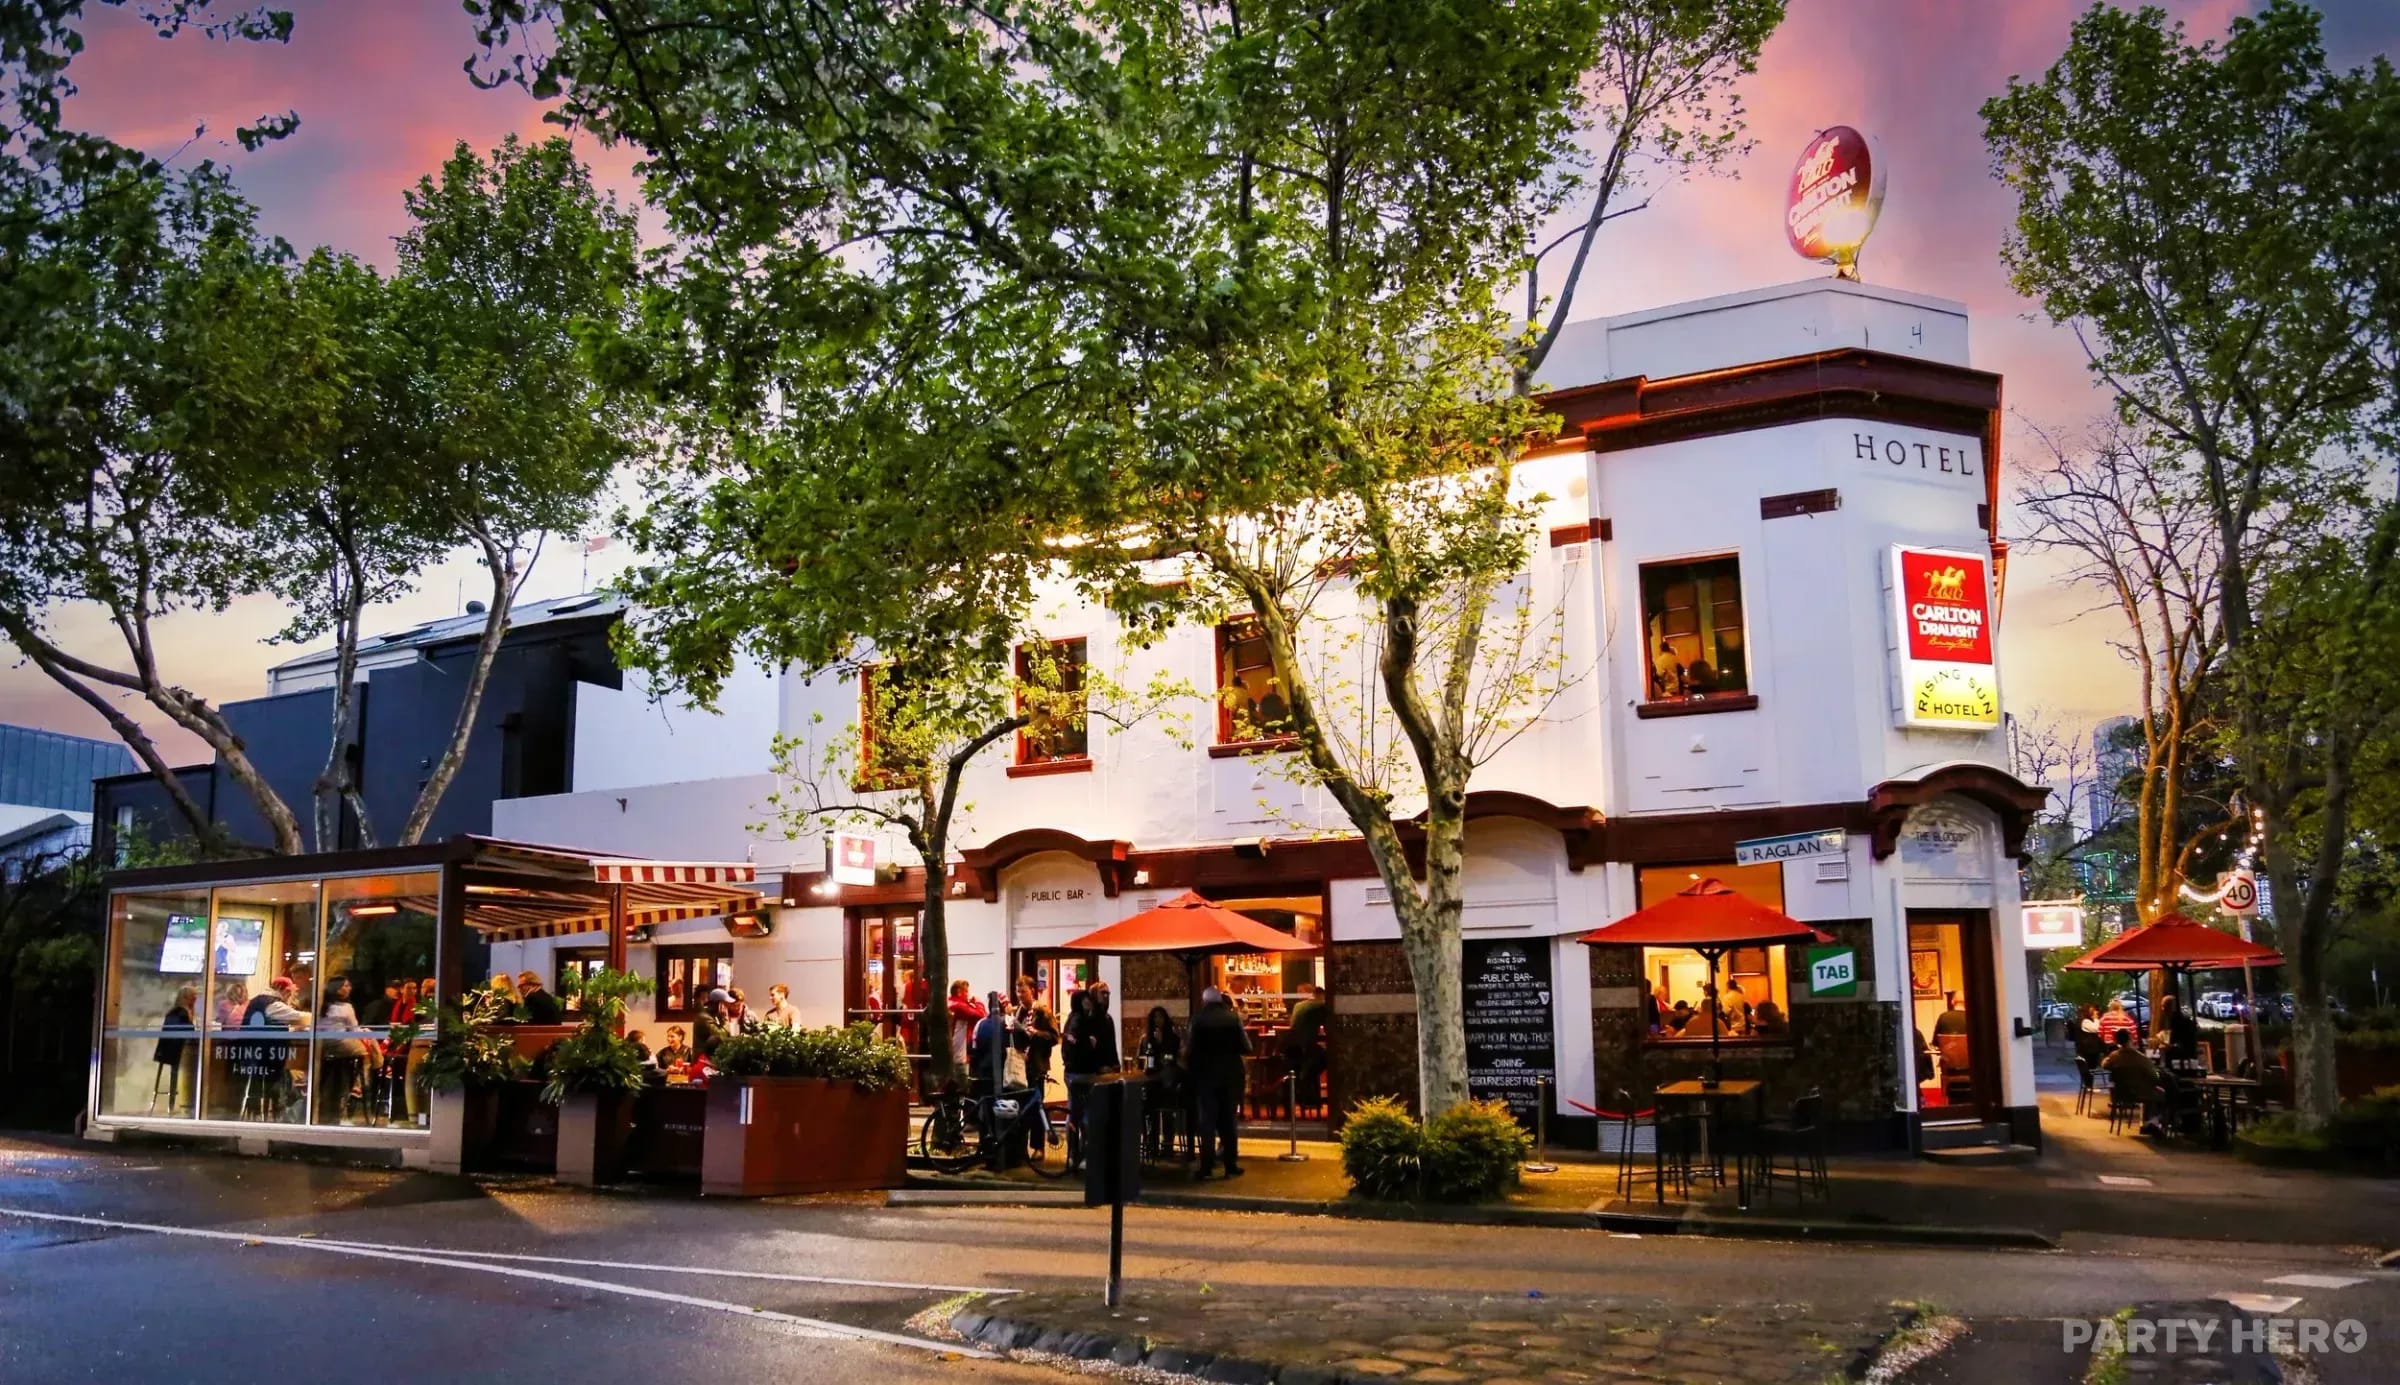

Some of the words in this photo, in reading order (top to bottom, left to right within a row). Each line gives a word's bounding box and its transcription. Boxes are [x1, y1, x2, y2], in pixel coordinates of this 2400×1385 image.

[1853, 433, 1974, 476] HOTEL
[1912, 602, 1983, 626] CARLTON
[1919, 620, 1979, 640] DRAUGHT
[1918, 669, 1962, 712] RISING
[1967, 677, 1993, 715] SUN
[1933, 703, 1980, 717] HOTEL
[1753, 839, 1821, 861] RAGLAN
[1031, 891, 1061, 901] PUBLIC
[1067, 890, 1084, 900] BAR
[2226, 884, 2251, 902] 40
[1487, 957, 1510, 965] RISING
[1511, 956, 1527, 964] SUN
[1815, 965, 1849, 979] TAB
[215, 1046, 262, 1060] RISING
[269, 1047, 297, 1060] SUN
[240, 1066, 269, 1075] HOTEL
[1523, 1077, 1536, 1086] PUB
